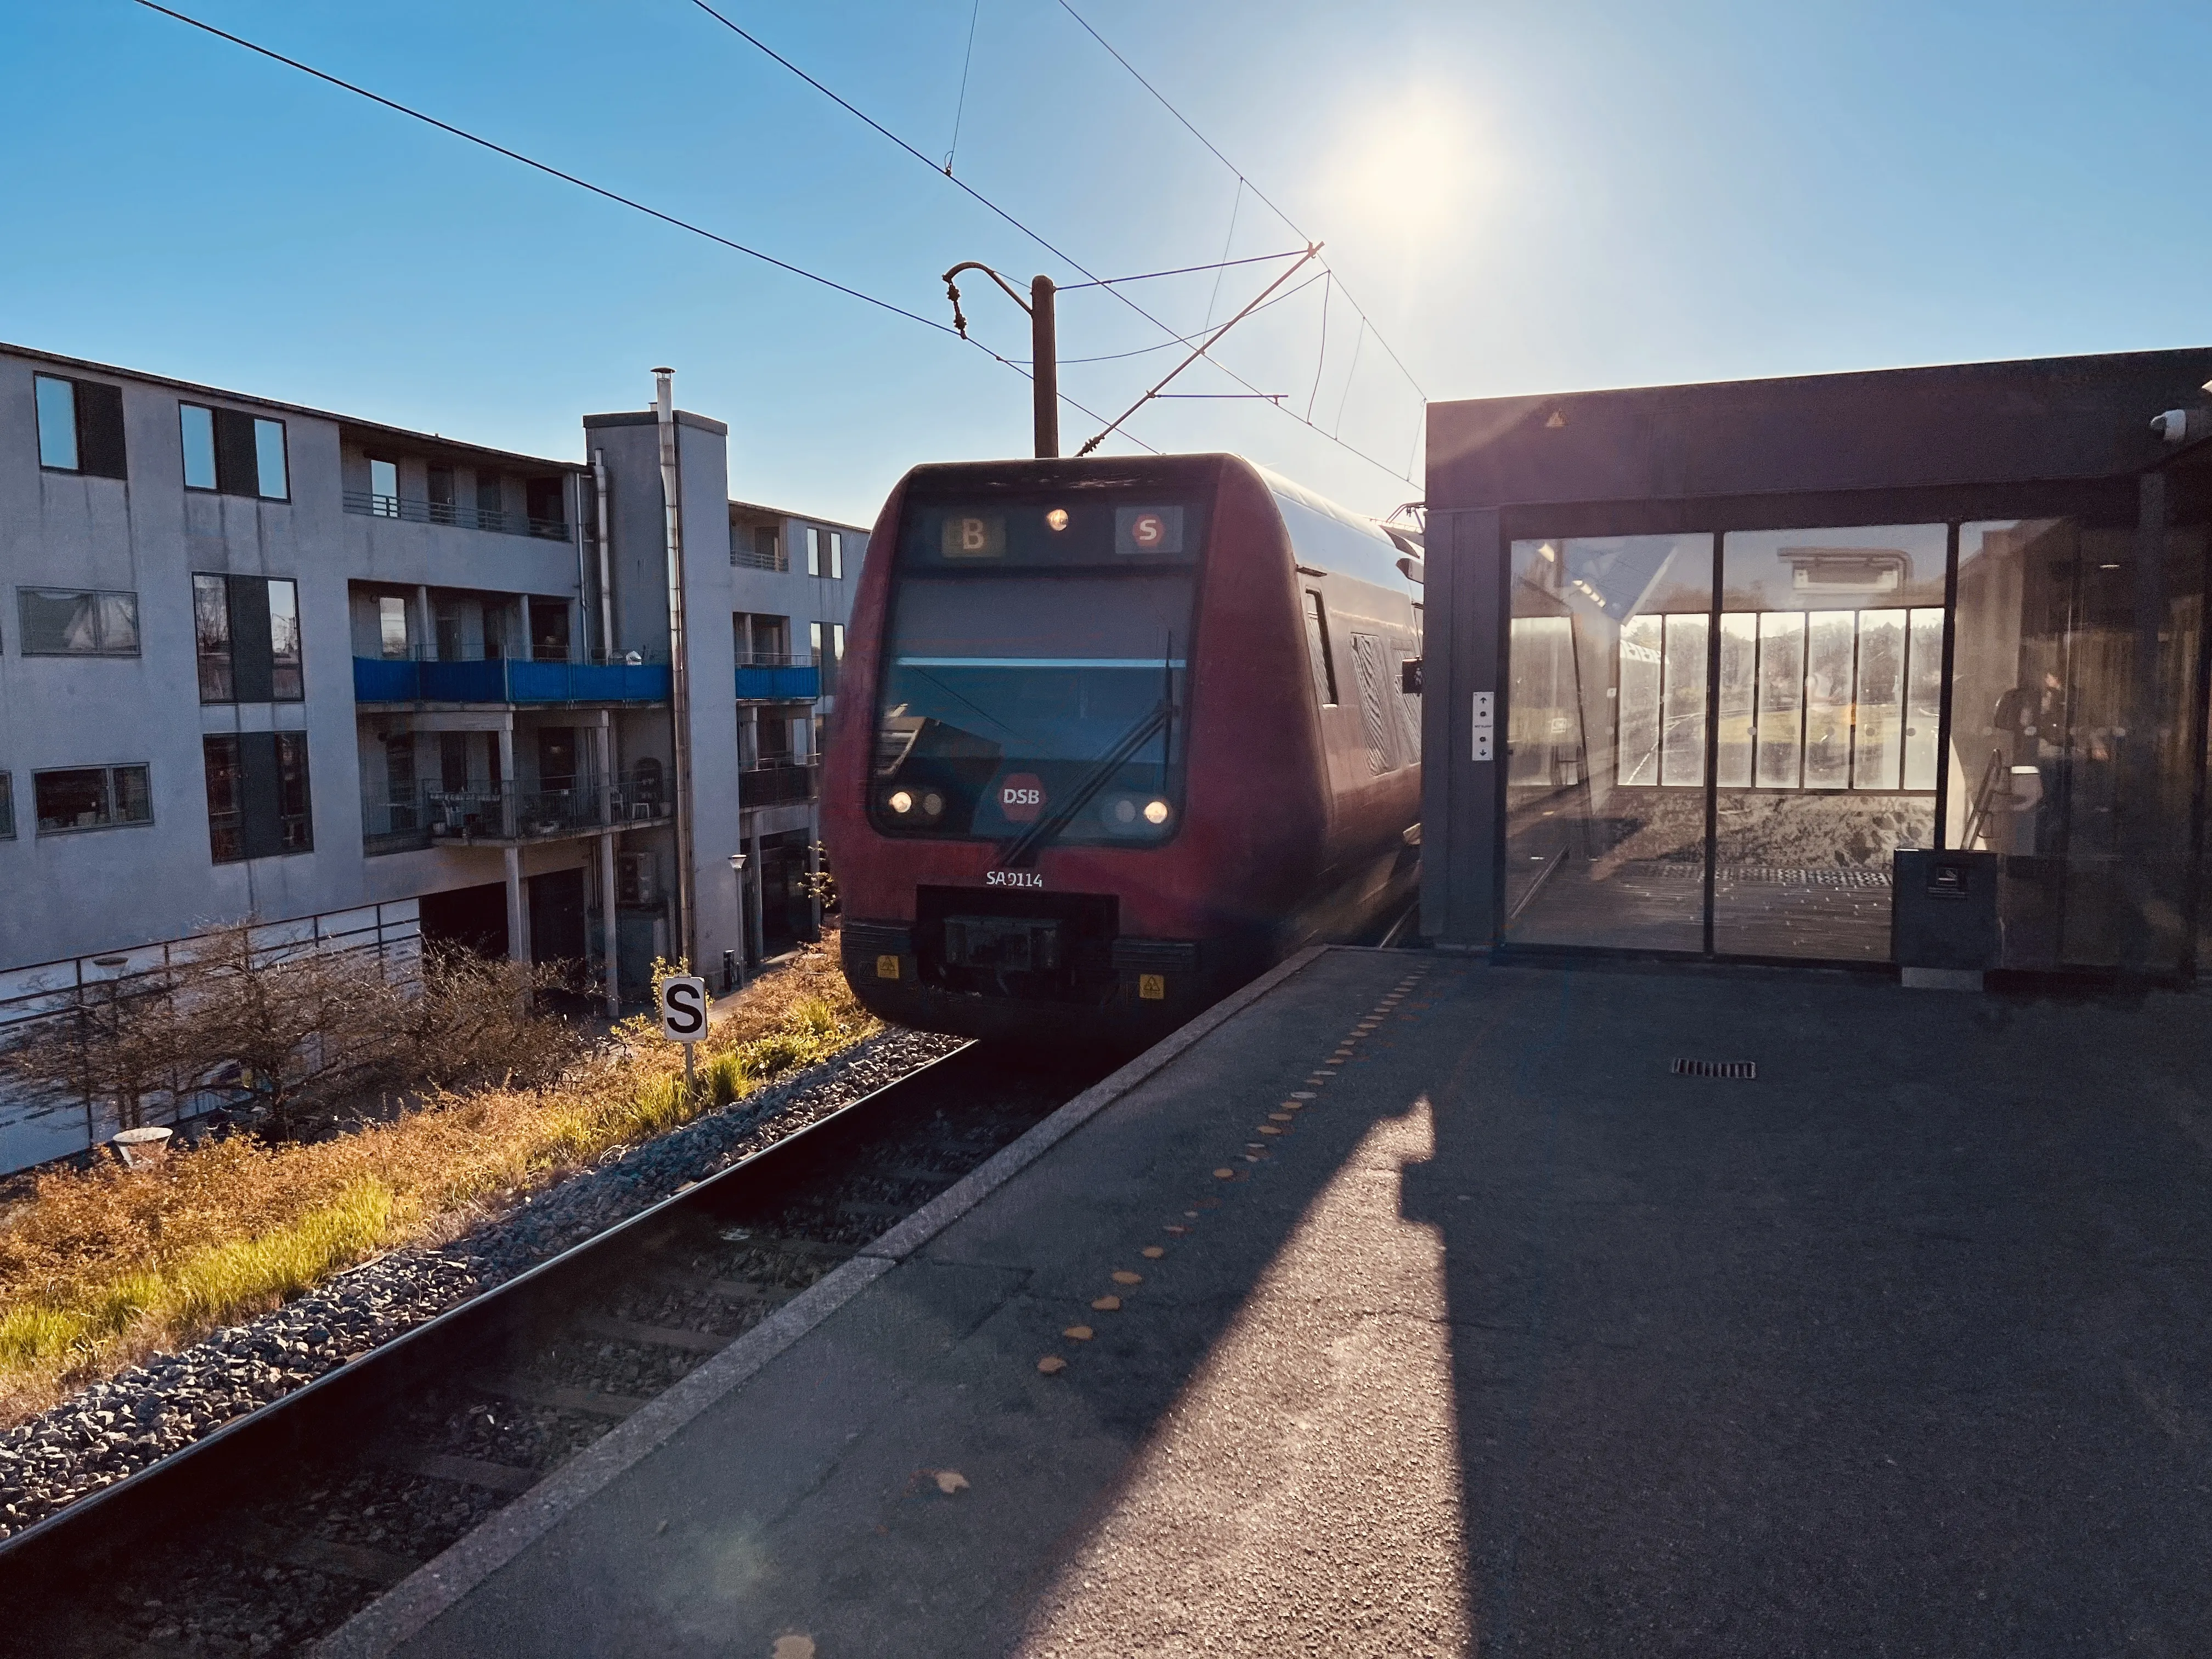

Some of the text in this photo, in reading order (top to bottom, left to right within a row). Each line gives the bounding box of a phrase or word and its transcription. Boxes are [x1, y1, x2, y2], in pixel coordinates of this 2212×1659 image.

[963, 518, 984, 549] B
[1139, 520, 1157, 540] S
[1003, 789, 1040, 804] DSB
[666, 984, 703, 1034] S
